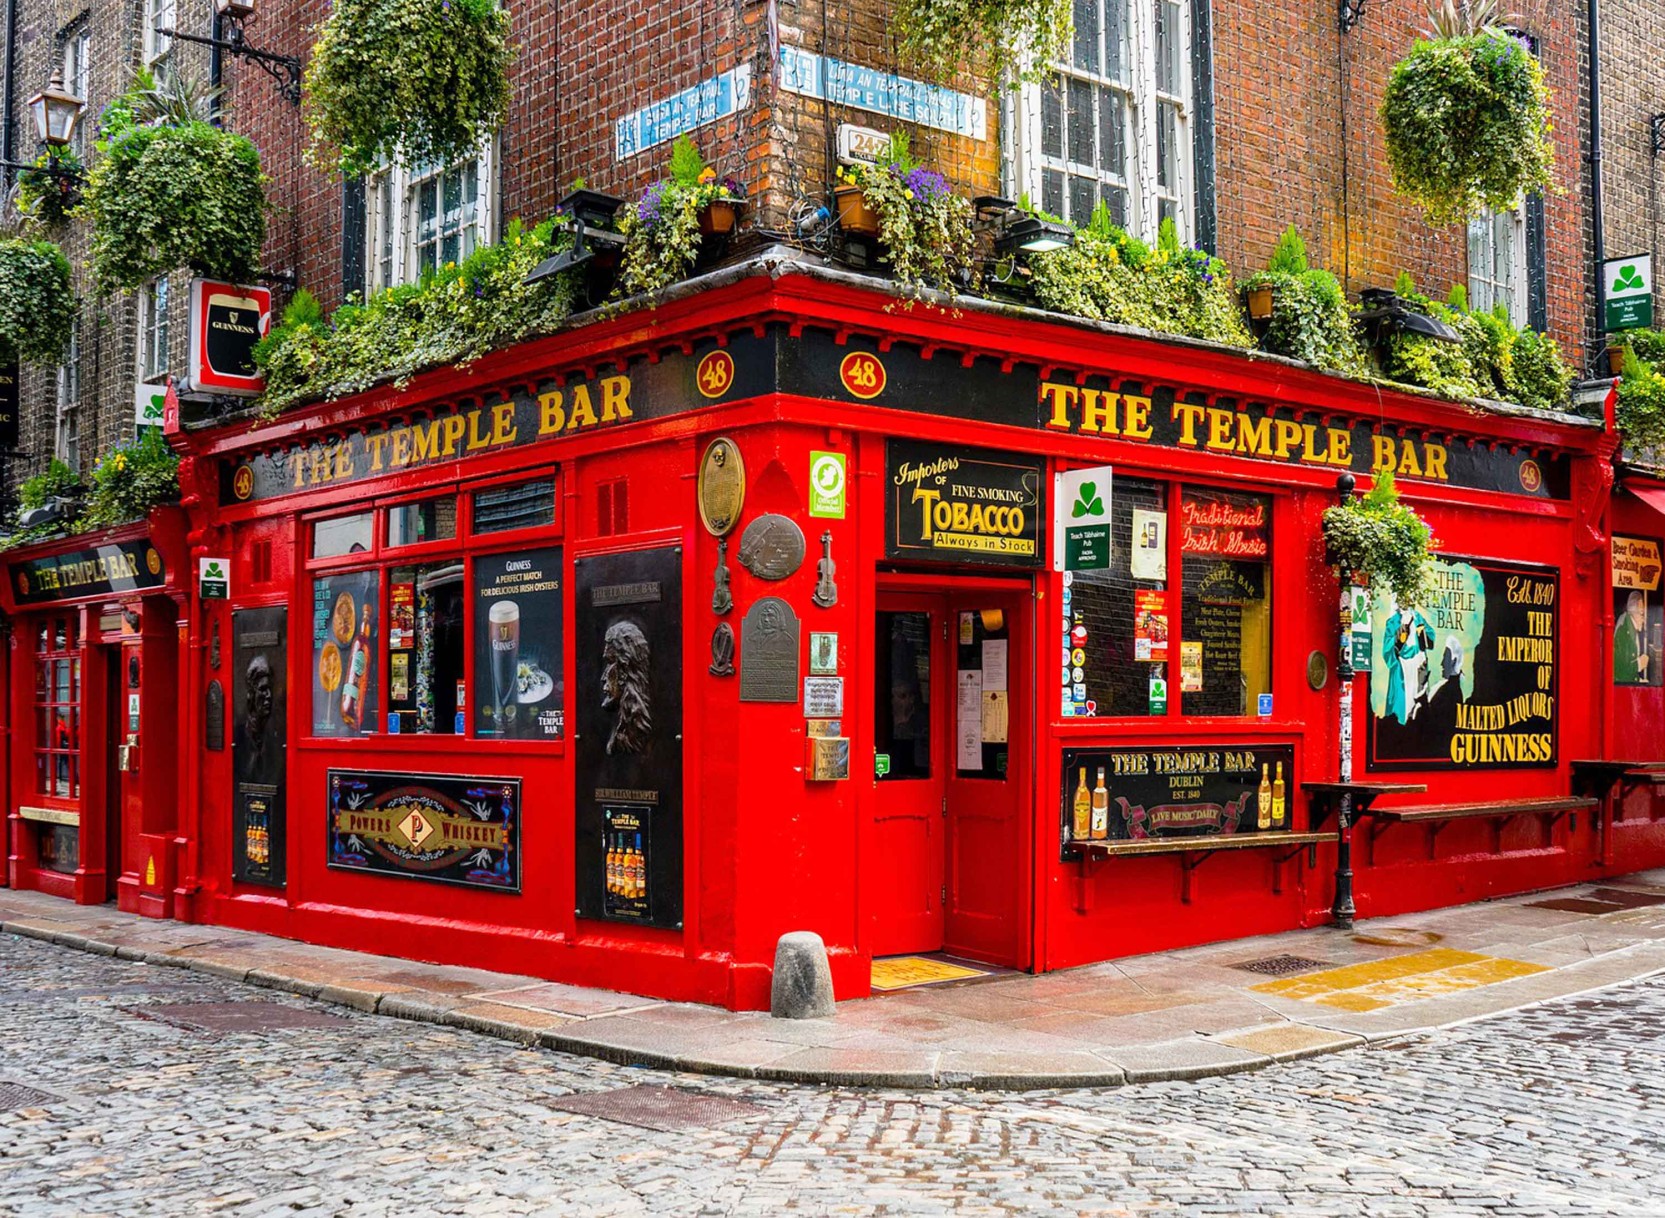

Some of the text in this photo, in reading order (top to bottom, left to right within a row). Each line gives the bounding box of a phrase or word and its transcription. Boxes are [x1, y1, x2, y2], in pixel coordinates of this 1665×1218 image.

[857, 72, 872, 88] AN
[828, 81, 875, 107] TEMPLE
[914, 105, 957, 129] SOUTH
[212, 321, 254, 334] GUINNESS
[702, 359, 727, 390] 48
[847, 357, 877, 388] 48
[288, 374, 633, 488] THE TEMPLE BAR
[1041, 382, 1449, 480] THE TEMPLE BAR
[236, 467, 251, 495] 48
[894, 456, 959, 489] Importers
[934, 475, 947, 485] OF
[1522, 463, 1537, 486] 48
[951, 484, 1024, 503] FINE SMOKING
[911, 487, 1025, 541] TOBACCO
[1182, 502, 1263, 526] Traditional
[935, 532, 1035, 553] Always in Stock
[1181, 527, 1267, 555] Irish Music
[1612, 540, 1627, 556] Beer
[1628, 543, 1652, 559] Garden
[35, 553, 140, 590] THE TEMPLE BAR
[505, 559, 532, 572] GUINNESS
[1612, 556, 1639, 575] Smoking
[481, 580, 559, 597] FOR DELICIOUS IRISH OYSTERS
[495, 571, 543, 584] A PERFECT MATCH
[1437, 570, 1464, 591] THE
[1617, 571, 1633, 586] Area
[1533, 582, 1554, 606] 1840
[1437, 610, 1464, 632] BAR
[1527, 611, 1553, 637] THE
[1497, 635, 1554, 664] EMPEROR
[1536, 665, 1553, 690] OF
[538, 716, 564, 726] TEMPLE
[1454, 691, 1555, 731] MALTED LIQUORS
[544, 725, 559, 734] BAR
[1450, 733, 1553, 763] GUINNESS
[1111, 751, 1257, 776] THE TEMPLE BAR
[1168, 775, 1204, 789] DUBLIN
[1172, 790, 1187, 800] EST.
[349, 814, 392, 834] POWERS
[411, 814, 423, 840] P
[1151, 809, 1218, 824] LIVE MUSIC DAILY
[441, 821, 497, 843] WHISKEY
